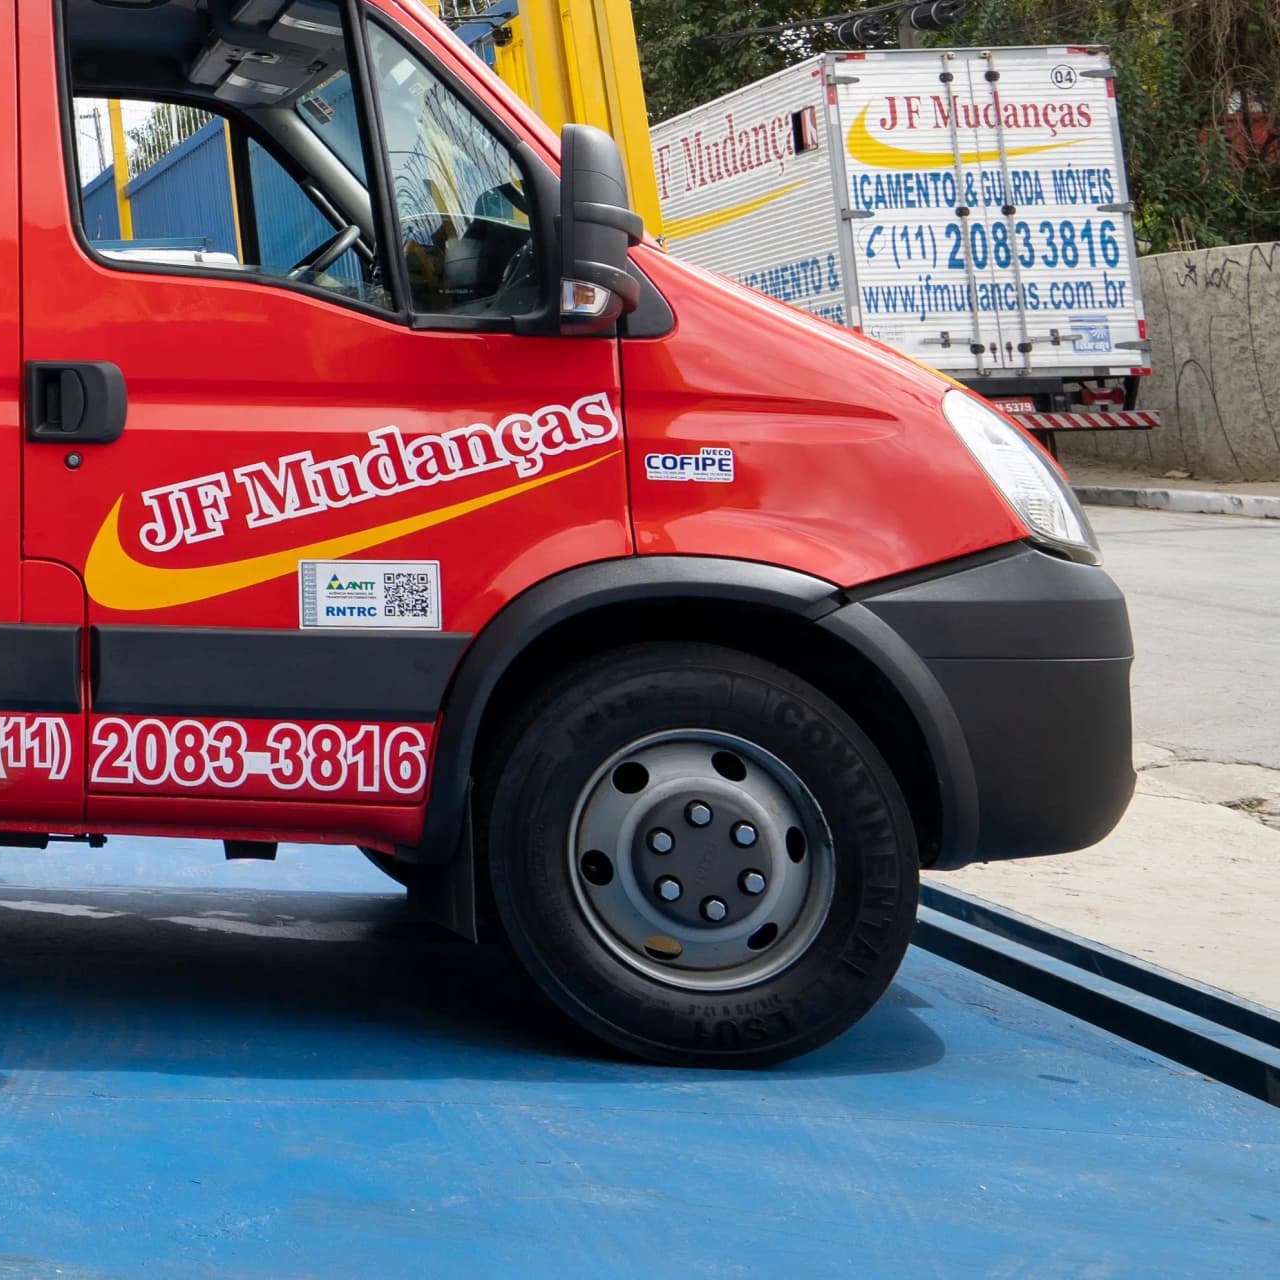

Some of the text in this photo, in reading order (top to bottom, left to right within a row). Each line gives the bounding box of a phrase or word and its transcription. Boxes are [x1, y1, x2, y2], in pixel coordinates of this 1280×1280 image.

[1054, 70, 1073, 85] 04
[930, 91, 1092, 136] Mudanças
[965, 172, 978, 208] &
[1052, 163, 1115, 206] MÓVEIS
[891, 224, 937, 269] (11)
[646, 455, 732, 472] COFIPE
[701, 448, 731, 456] IVECO
[139, 392, 619, 552] JF Mudanças
[345, 581, 377, 591] ANTT
[325, 605, 378, 617] RNTRC
[91, 717, 427, 794] 2083-3816
